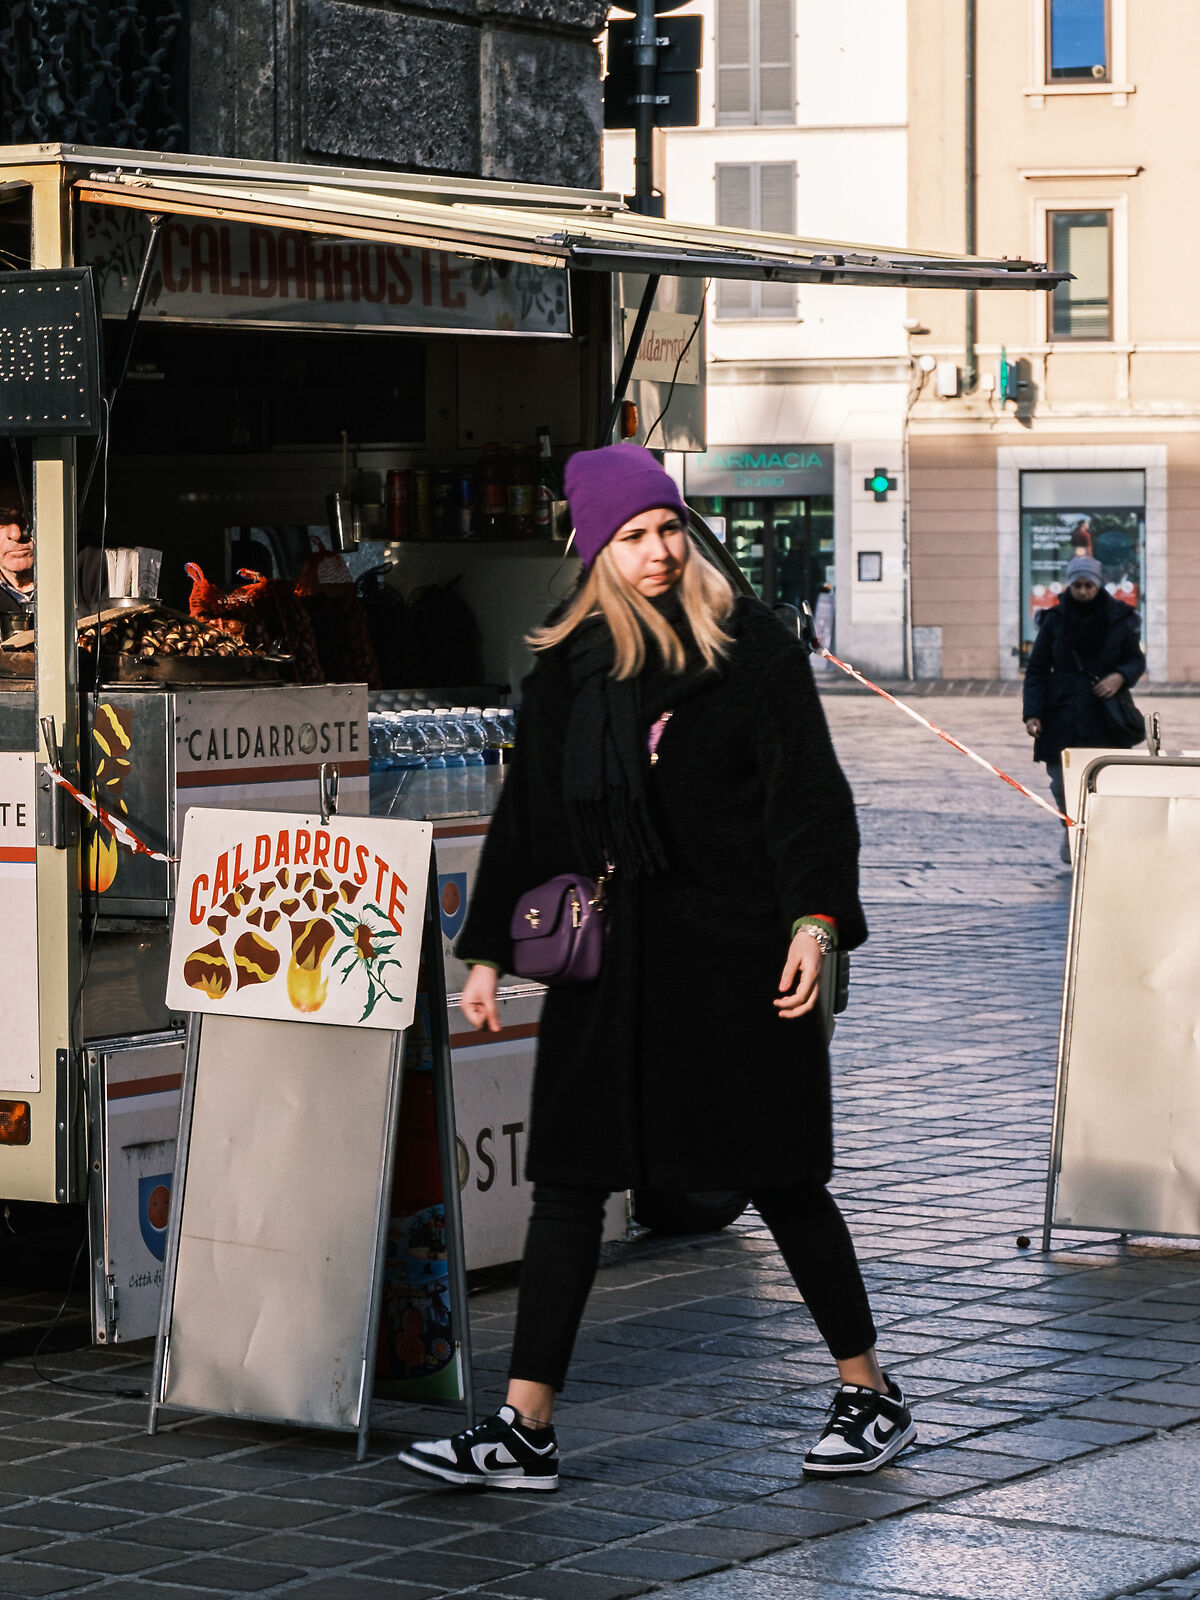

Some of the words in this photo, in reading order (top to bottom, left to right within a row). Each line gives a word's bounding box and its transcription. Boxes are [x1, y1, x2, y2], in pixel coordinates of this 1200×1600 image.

[161, 222, 466, 309] CALDARROSTE
[697, 452, 823, 469] FARMACIA
[188, 721, 359, 762] CALDARROSTE
[189, 829, 409, 937] CALDARROSTE
